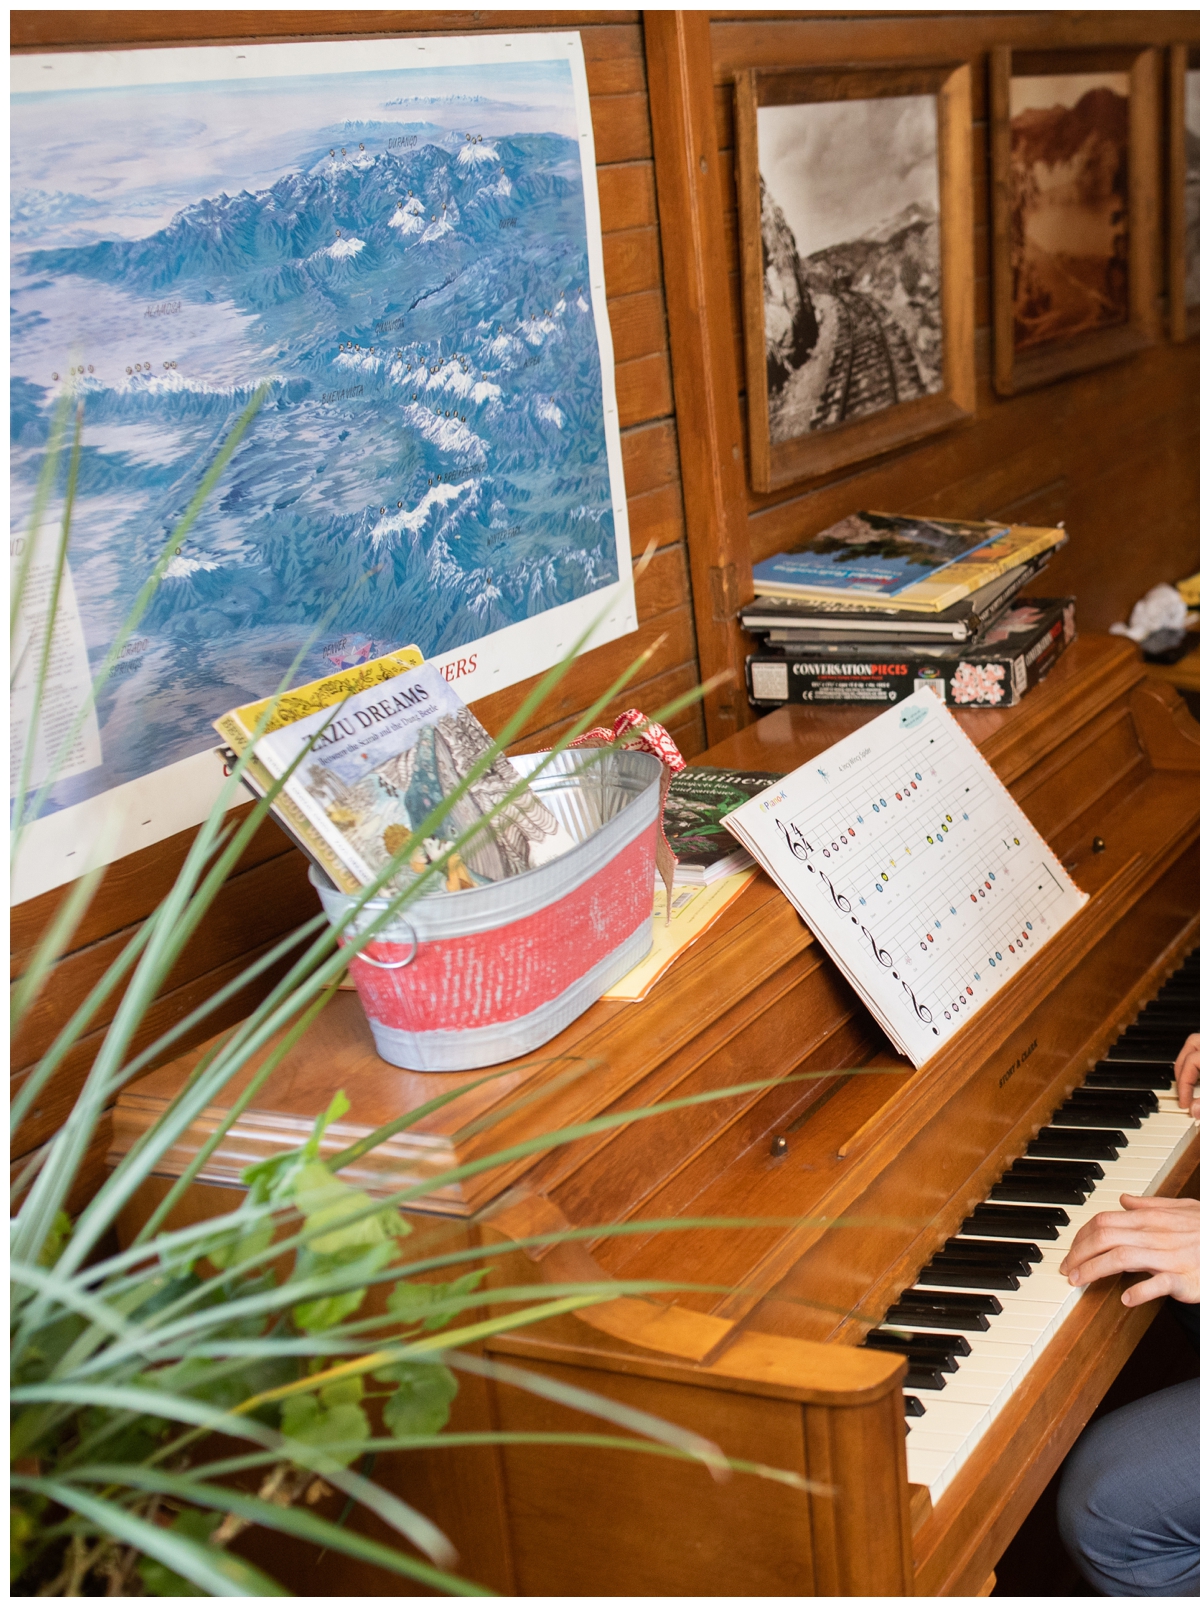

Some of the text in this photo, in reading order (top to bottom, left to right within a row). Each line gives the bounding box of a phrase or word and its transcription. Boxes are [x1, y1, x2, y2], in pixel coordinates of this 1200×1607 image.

[322, 638, 348, 659] DENVER
[353, 684, 430, 728] DREAMS
[318, 748, 347, 766] Between
[358, 732, 379, 748] Scarab
[401, 713, 421, 728] Dung
[420, 704, 440, 720] Beetle
[1021, 1038, 1038, 1063] CLARK
